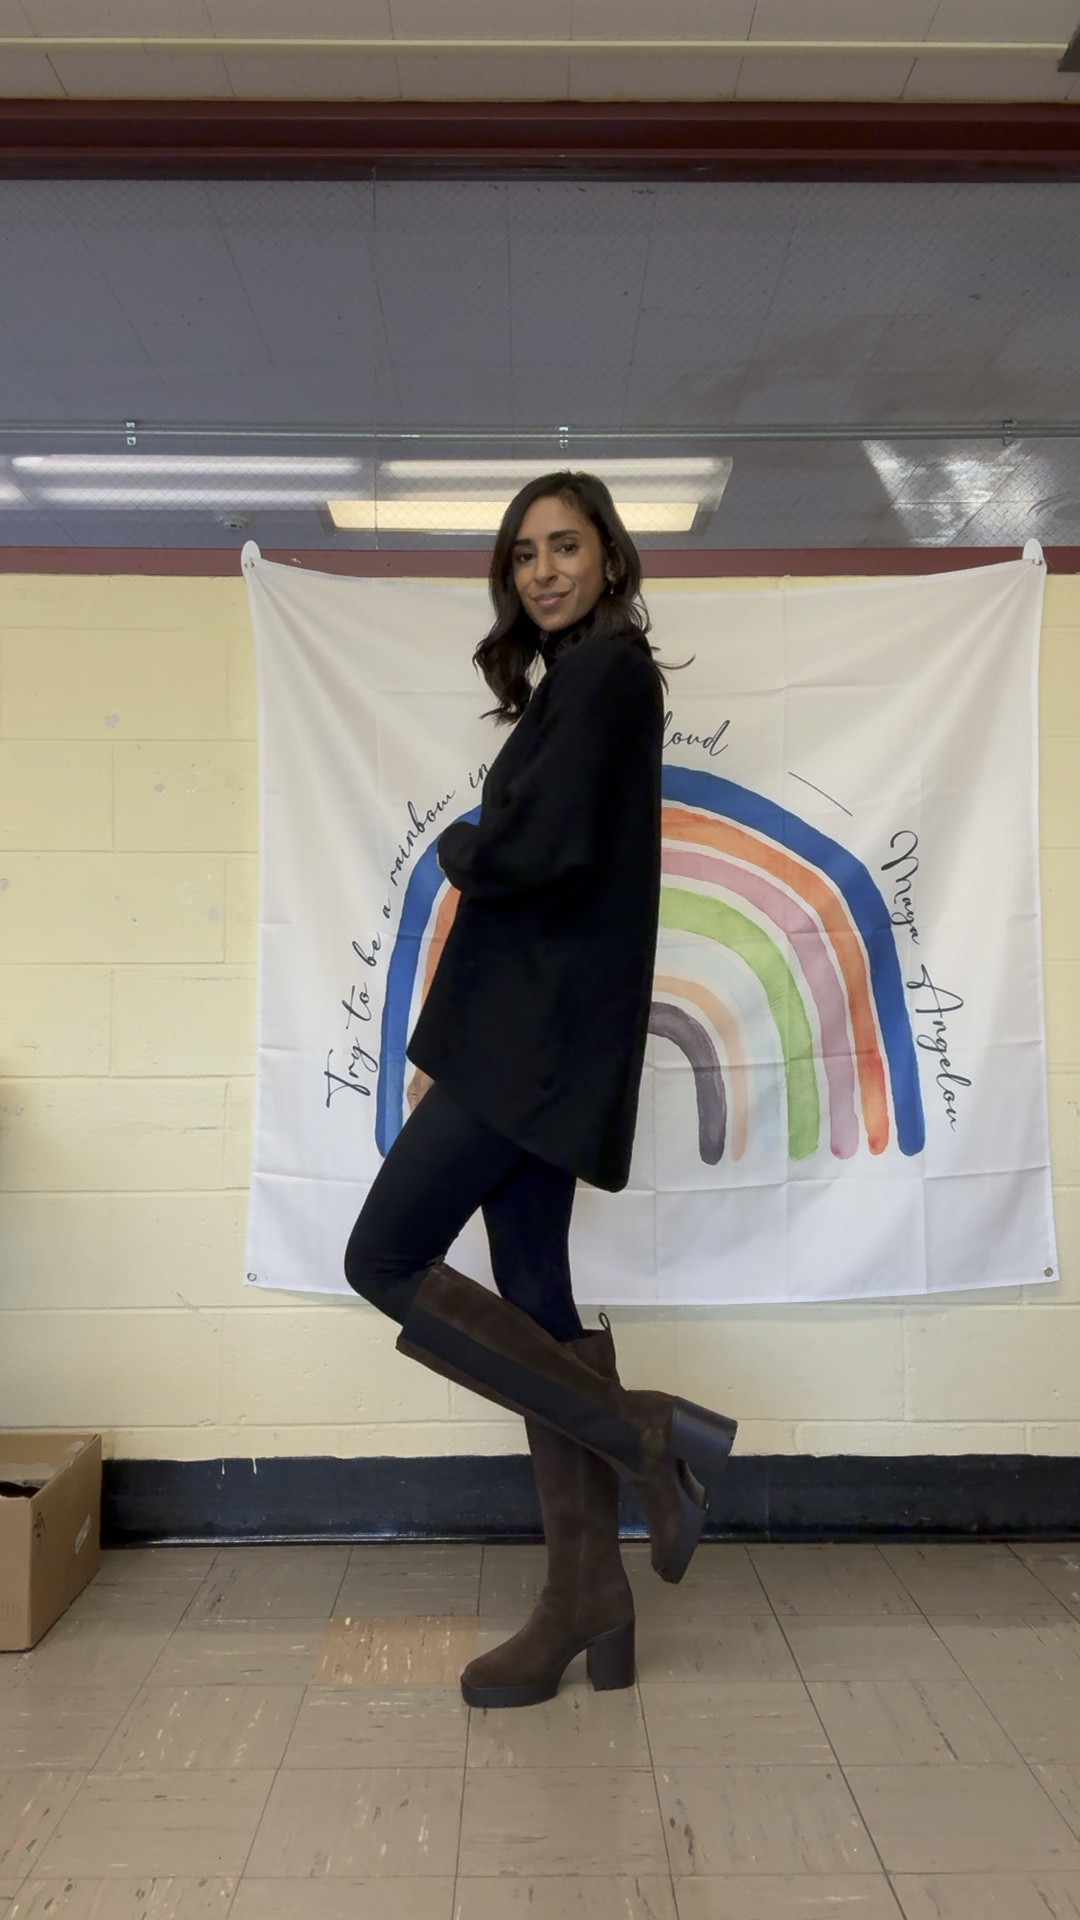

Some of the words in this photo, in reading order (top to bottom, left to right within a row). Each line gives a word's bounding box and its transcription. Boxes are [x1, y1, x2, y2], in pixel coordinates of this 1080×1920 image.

[662, 710, 731, 757] loud
[468, 763, 489, 789] in
[389, 790, 456, 887] rainbow
[382, 897, 392, 919] a
[352, 931, 382, 967] be
[880, 830, 920, 945] Maya
[906, 963, 972, 1133] Angelou
[341, 982, 373, 1030] to
[324, 1036, 379, 1108] Try
